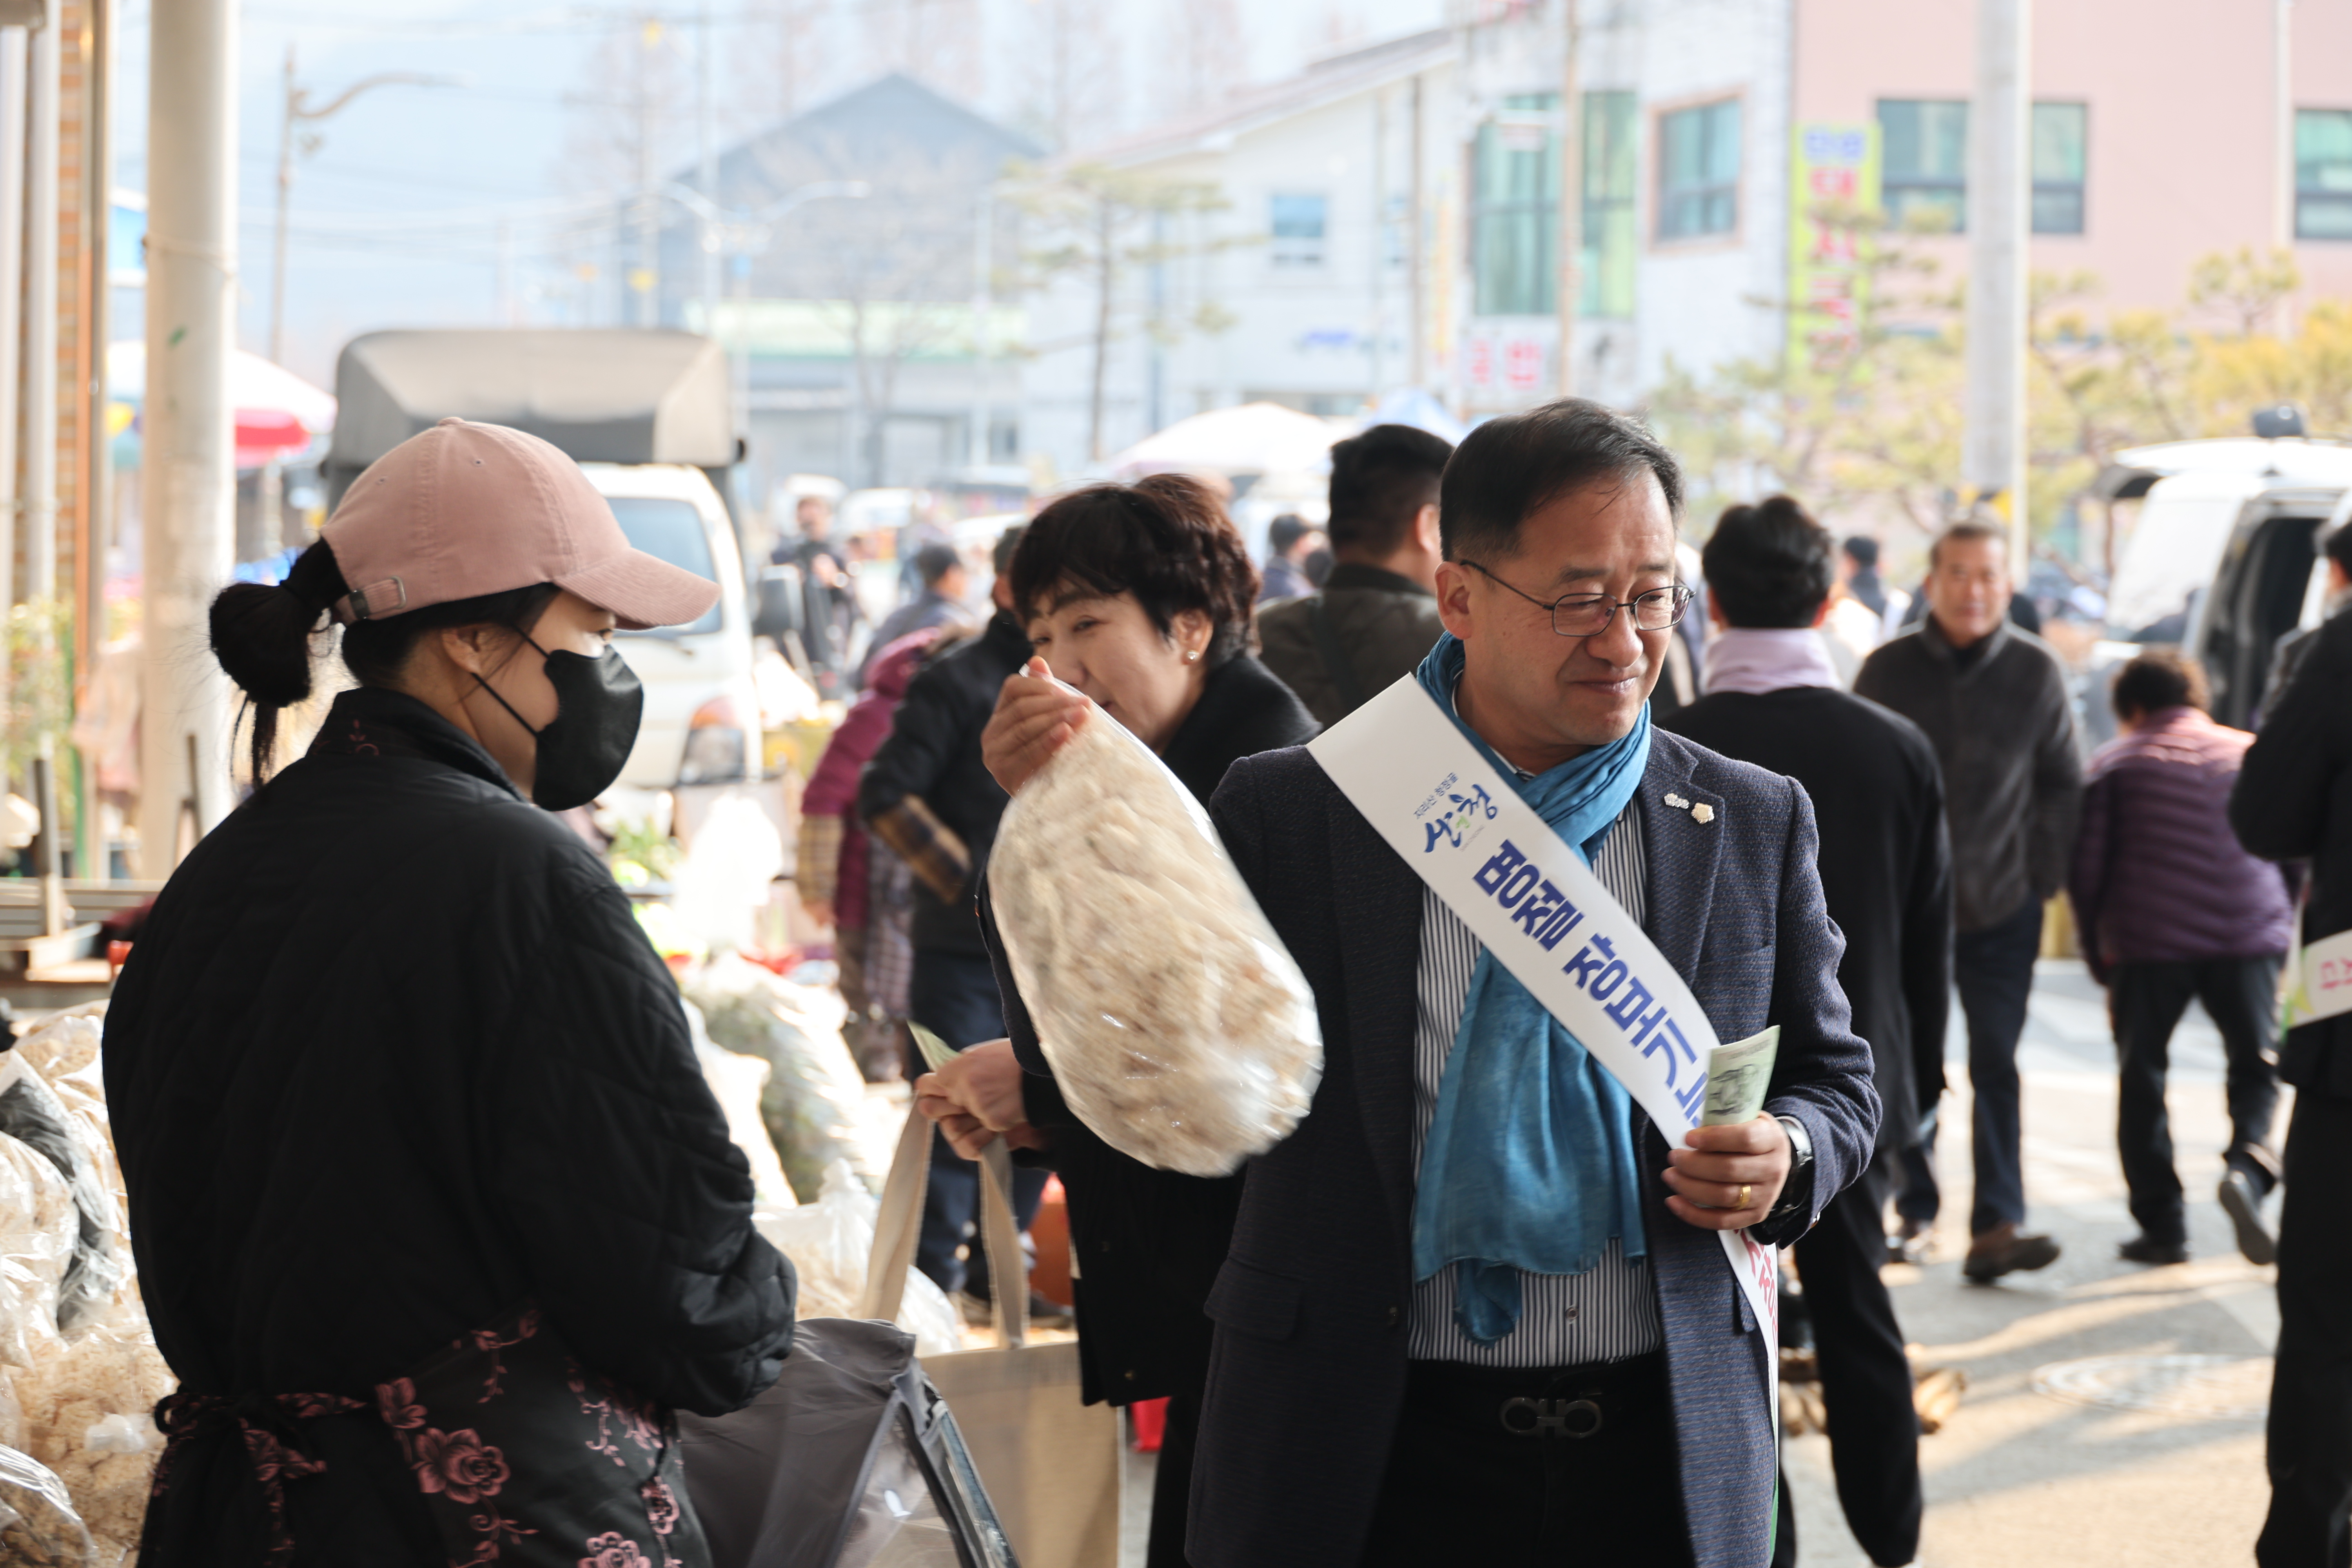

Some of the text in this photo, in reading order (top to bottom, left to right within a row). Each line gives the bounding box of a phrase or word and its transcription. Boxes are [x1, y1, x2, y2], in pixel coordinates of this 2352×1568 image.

[1413, 772, 1458, 820] 지리산 청정골
[1472, 838, 1586, 953] 명절
